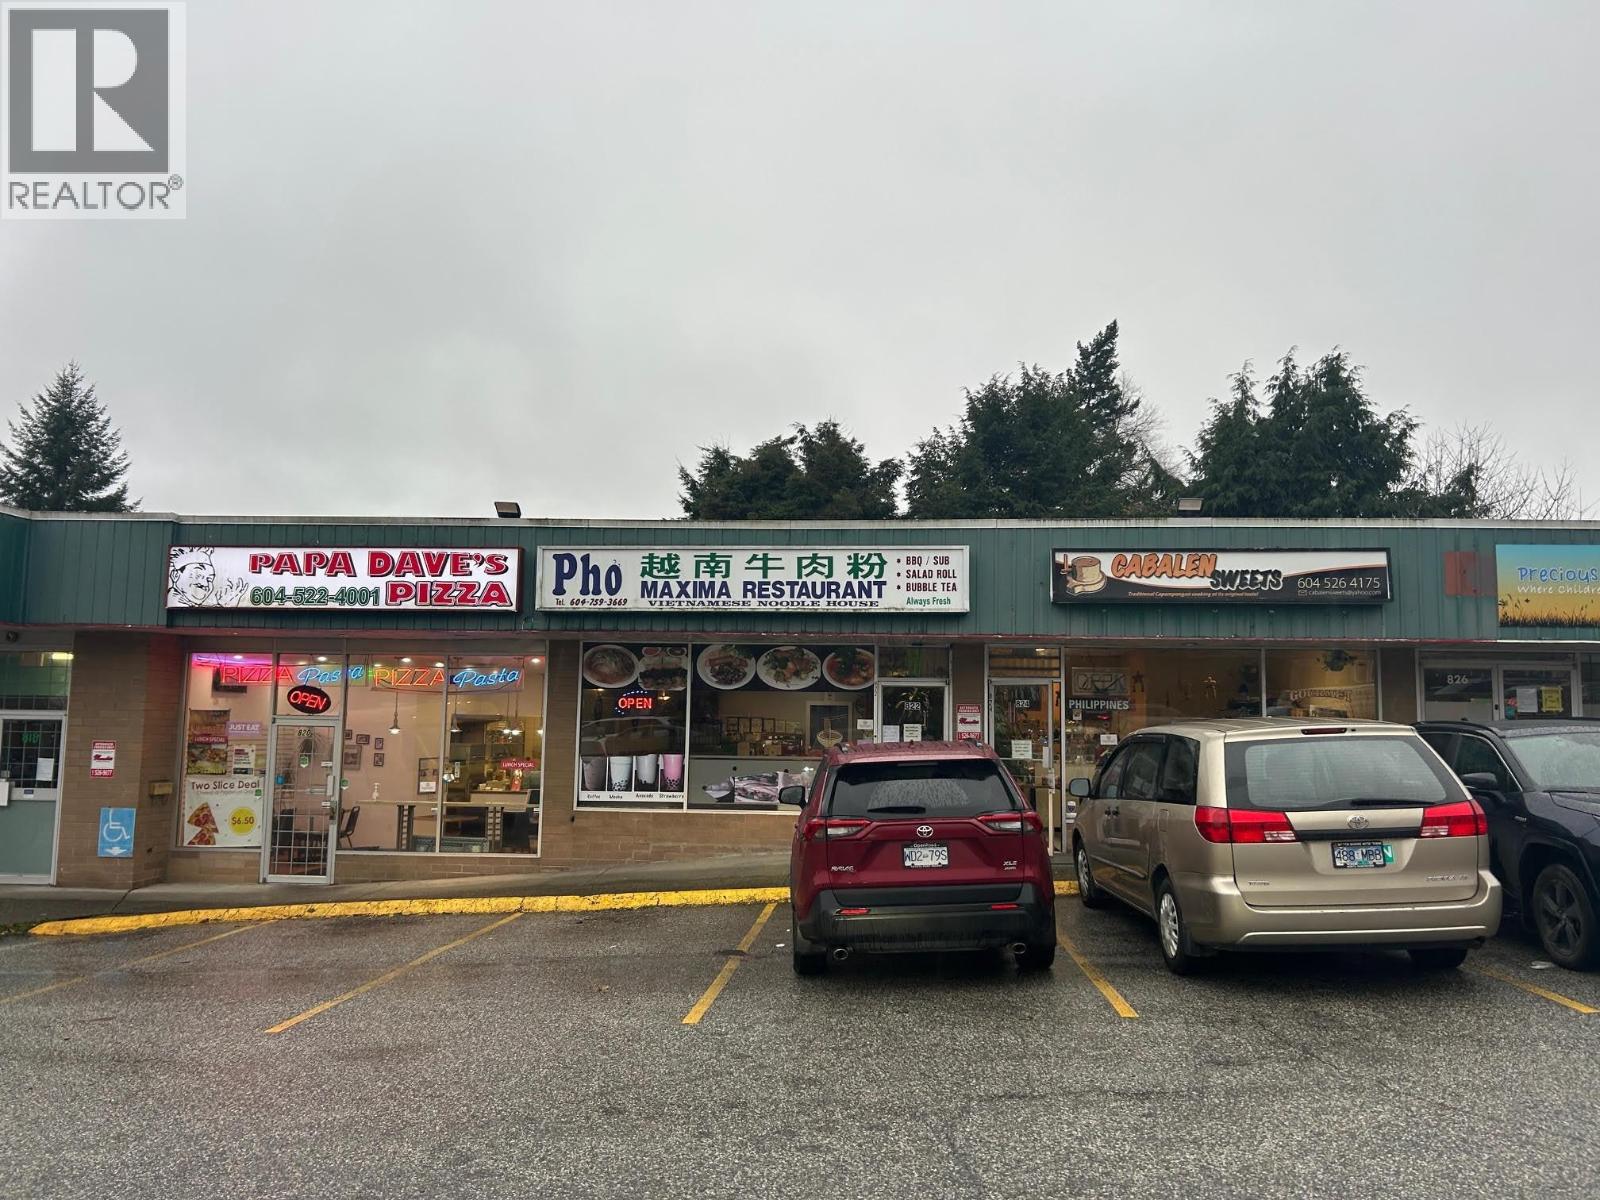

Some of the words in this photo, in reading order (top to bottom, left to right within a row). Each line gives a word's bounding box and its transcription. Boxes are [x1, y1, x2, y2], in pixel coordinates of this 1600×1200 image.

[249, 552, 357, 577] PAPA
[368, 550, 508, 577] DAVE'S
[640, 552, 888, 580] 越南牛肉粉
[906, 556, 923, 567] BBQ
[933, 556, 950, 566] SUB
[1110, 553, 1217, 579] CABALEN
[906, 569, 934, 579] SALAD
[937, 569, 957, 579] ROLL
[1210, 569, 1283, 591] SWEETS
[1518, 566, 1599, 582] Precious
[906, 582, 938, 592] BUBBLE
[941, 582, 957, 592] TEA
[1297, 577, 1320, 589] 604
[1324, 577, 1347, 589] 526
[1349, 577, 1381, 589] 4175
[250, 586, 380, 606] 604-522-4001
[385, 580, 512, 607] PIZZA
[640, 581, 732, 599] MAXIMA
[742, 581, 887, 599] RESTAURANT
[1518, 586, 1552, 594] Where
[569, 598, 628, 606] 604-759-3669
[906, 597, 930, 606] Always
[932, 597, 951, 606] Fresh
[220, 665, 294, 684] PIZZA
[375, 668, 445, 687] PIZZA
[452, 668, 519, 688] Pasta
[1447, 675, 1469, 684] 826
[290, 690, 327, 711] OPEN
[618, 698, 652, 709] OPEN
[1068, 699, 1130, 710] PHILIPPINES
[192, 781, 210, 790] Two
[213, 781, 235, 790] Slice
[237, 780, 260, 789] Deal
[231, 816, 255, 825] $6.50
[1335, 850, 1356, 861] 488
[1361, 849, 1383, 861] MBB
